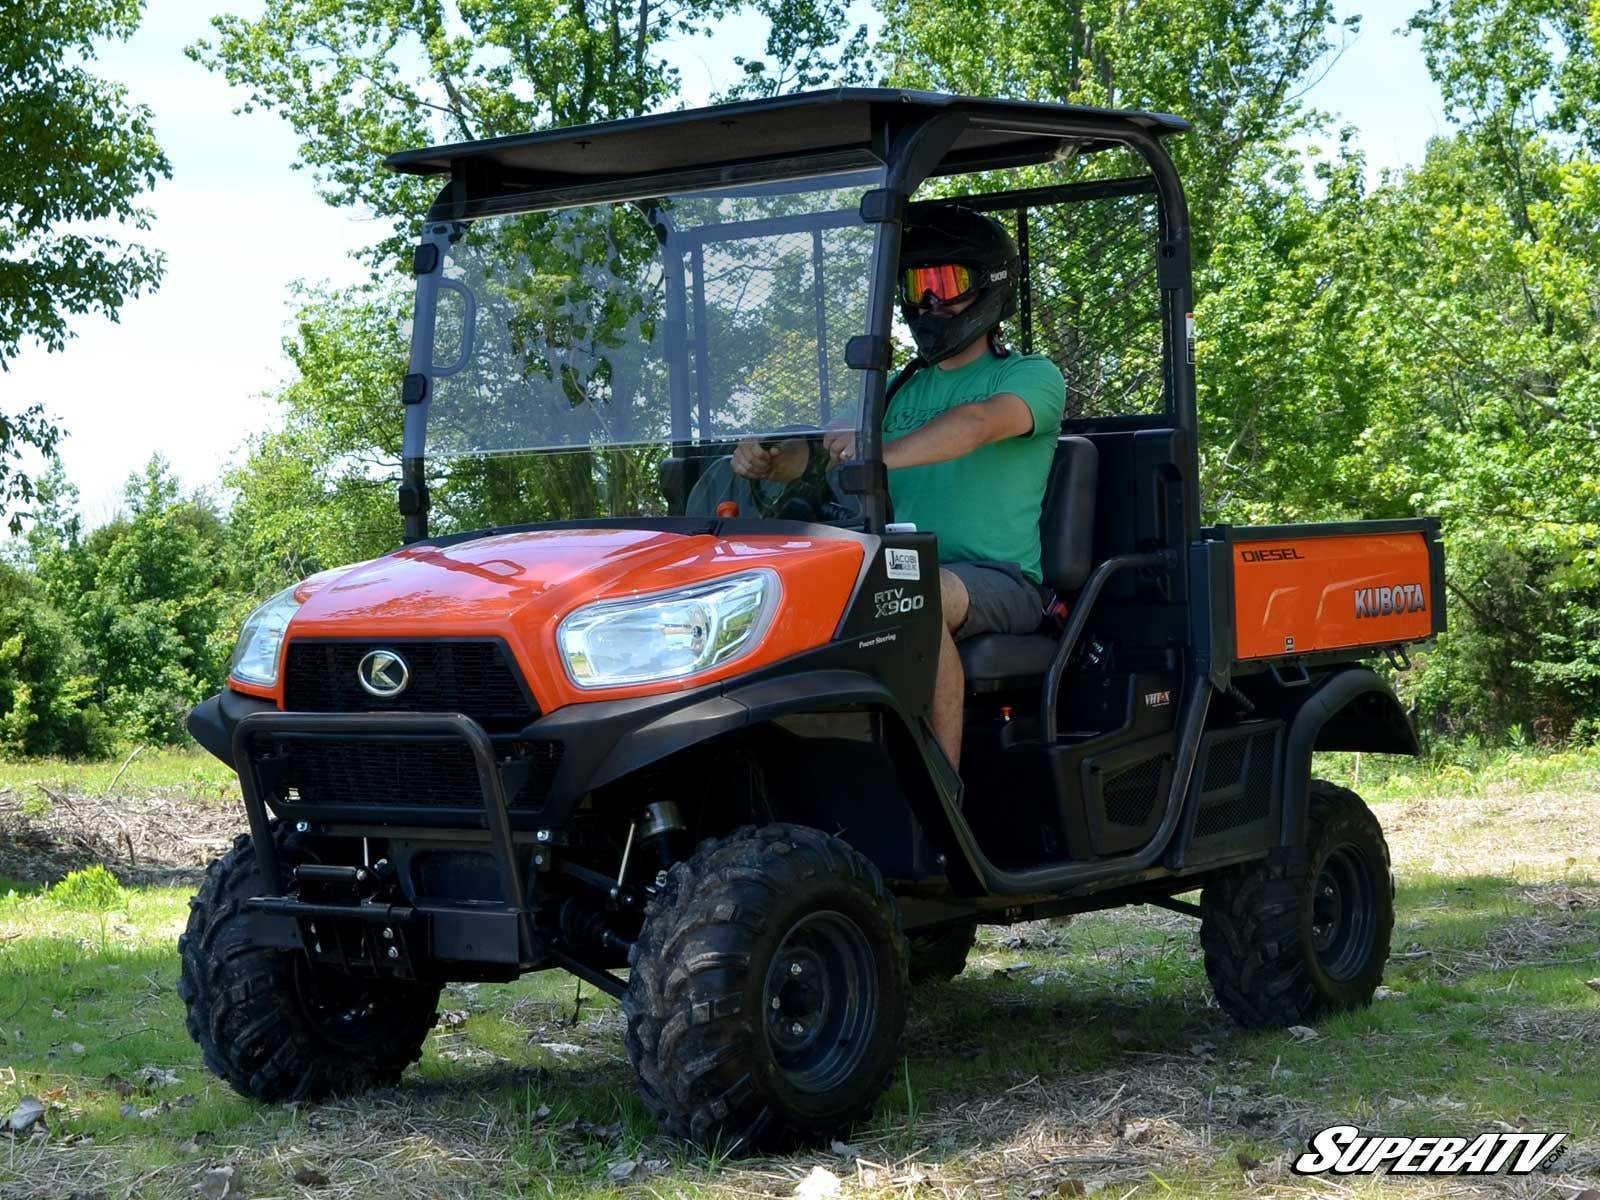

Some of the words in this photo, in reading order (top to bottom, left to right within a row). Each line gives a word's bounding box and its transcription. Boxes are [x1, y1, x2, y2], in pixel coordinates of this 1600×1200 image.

[1241, 548, 1305, 563] DIESEL
[874, 587, 904, 603] RTV
[1354, 583, 1425, 619] KUBOTA
[874, 595, 924, 618] X900
